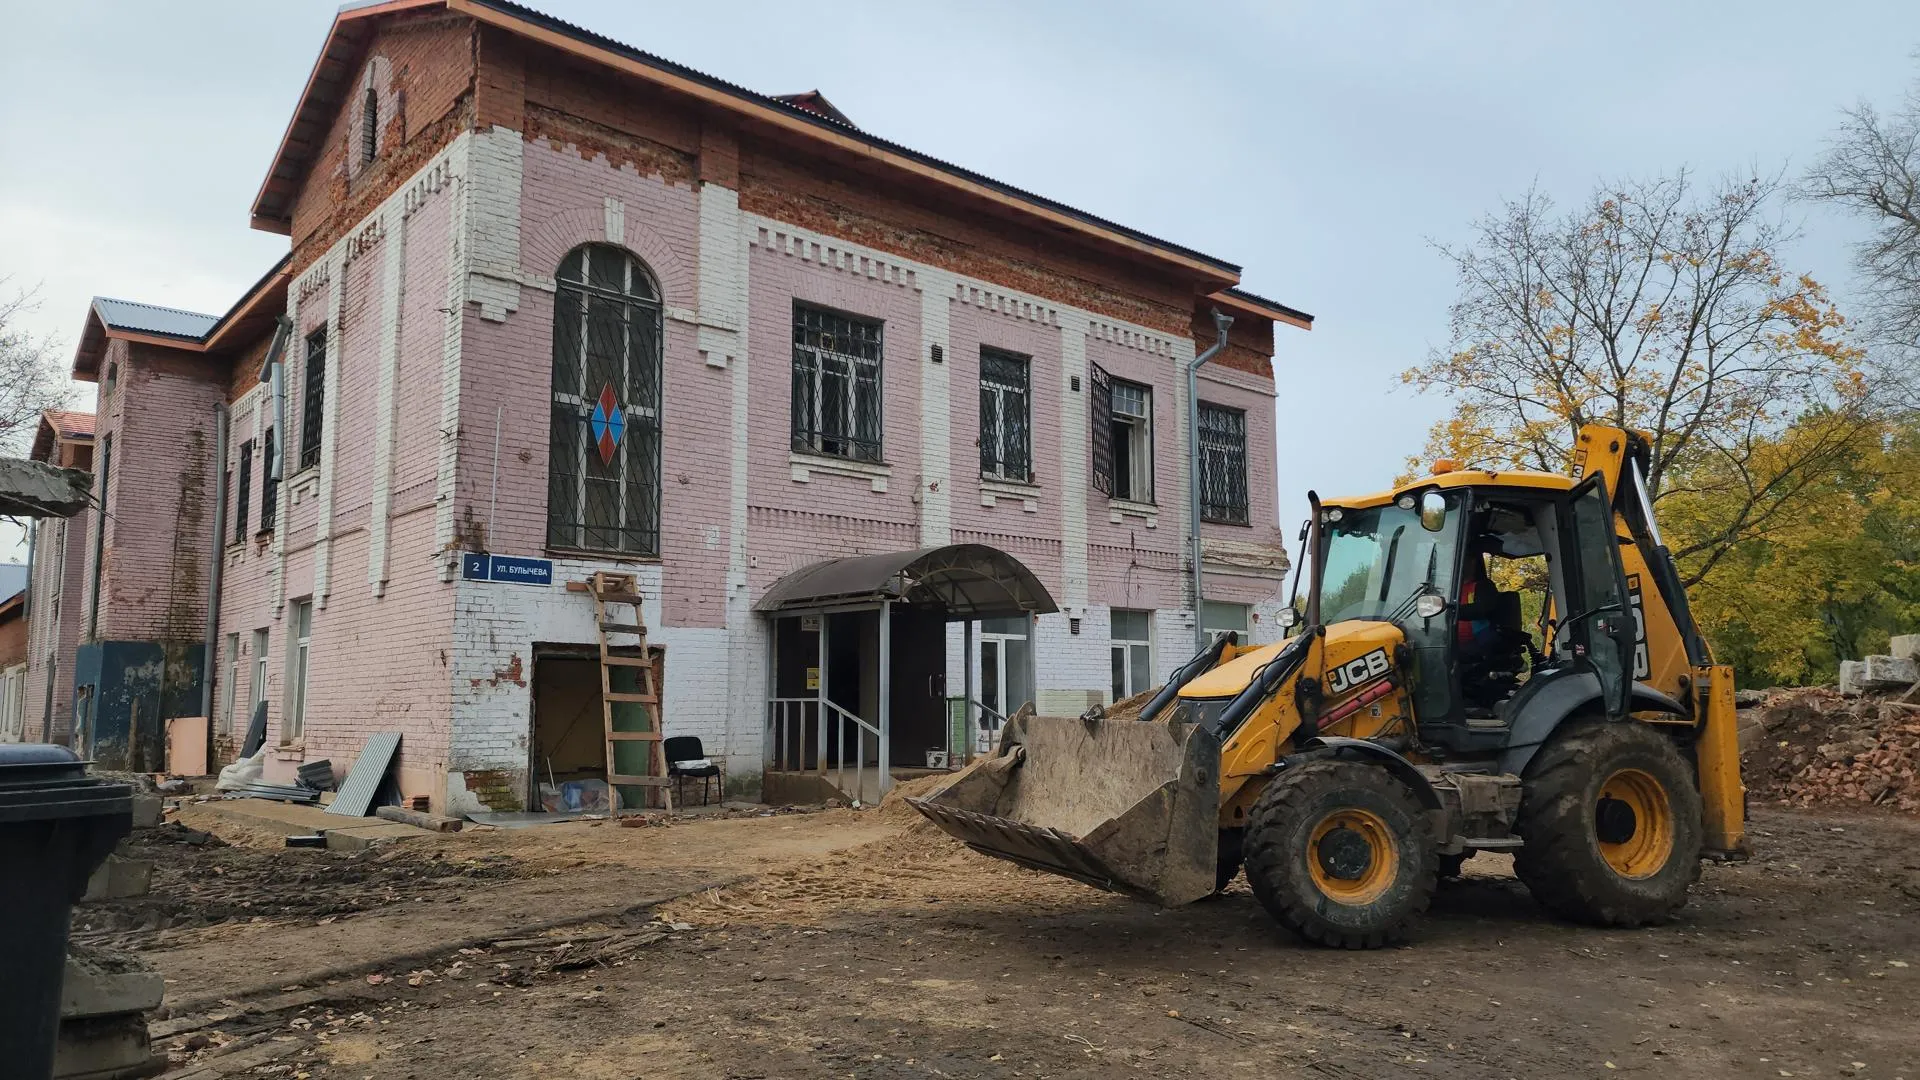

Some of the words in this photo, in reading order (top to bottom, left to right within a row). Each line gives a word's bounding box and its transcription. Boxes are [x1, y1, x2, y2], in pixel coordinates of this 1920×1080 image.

[472, 562, 480, 572] 2
[496, 564, 507, 573] УЛ.
[509, 566, 548, 577] БУЛЫЧЕВА
[1331, 650, 1390, 693] JCB
